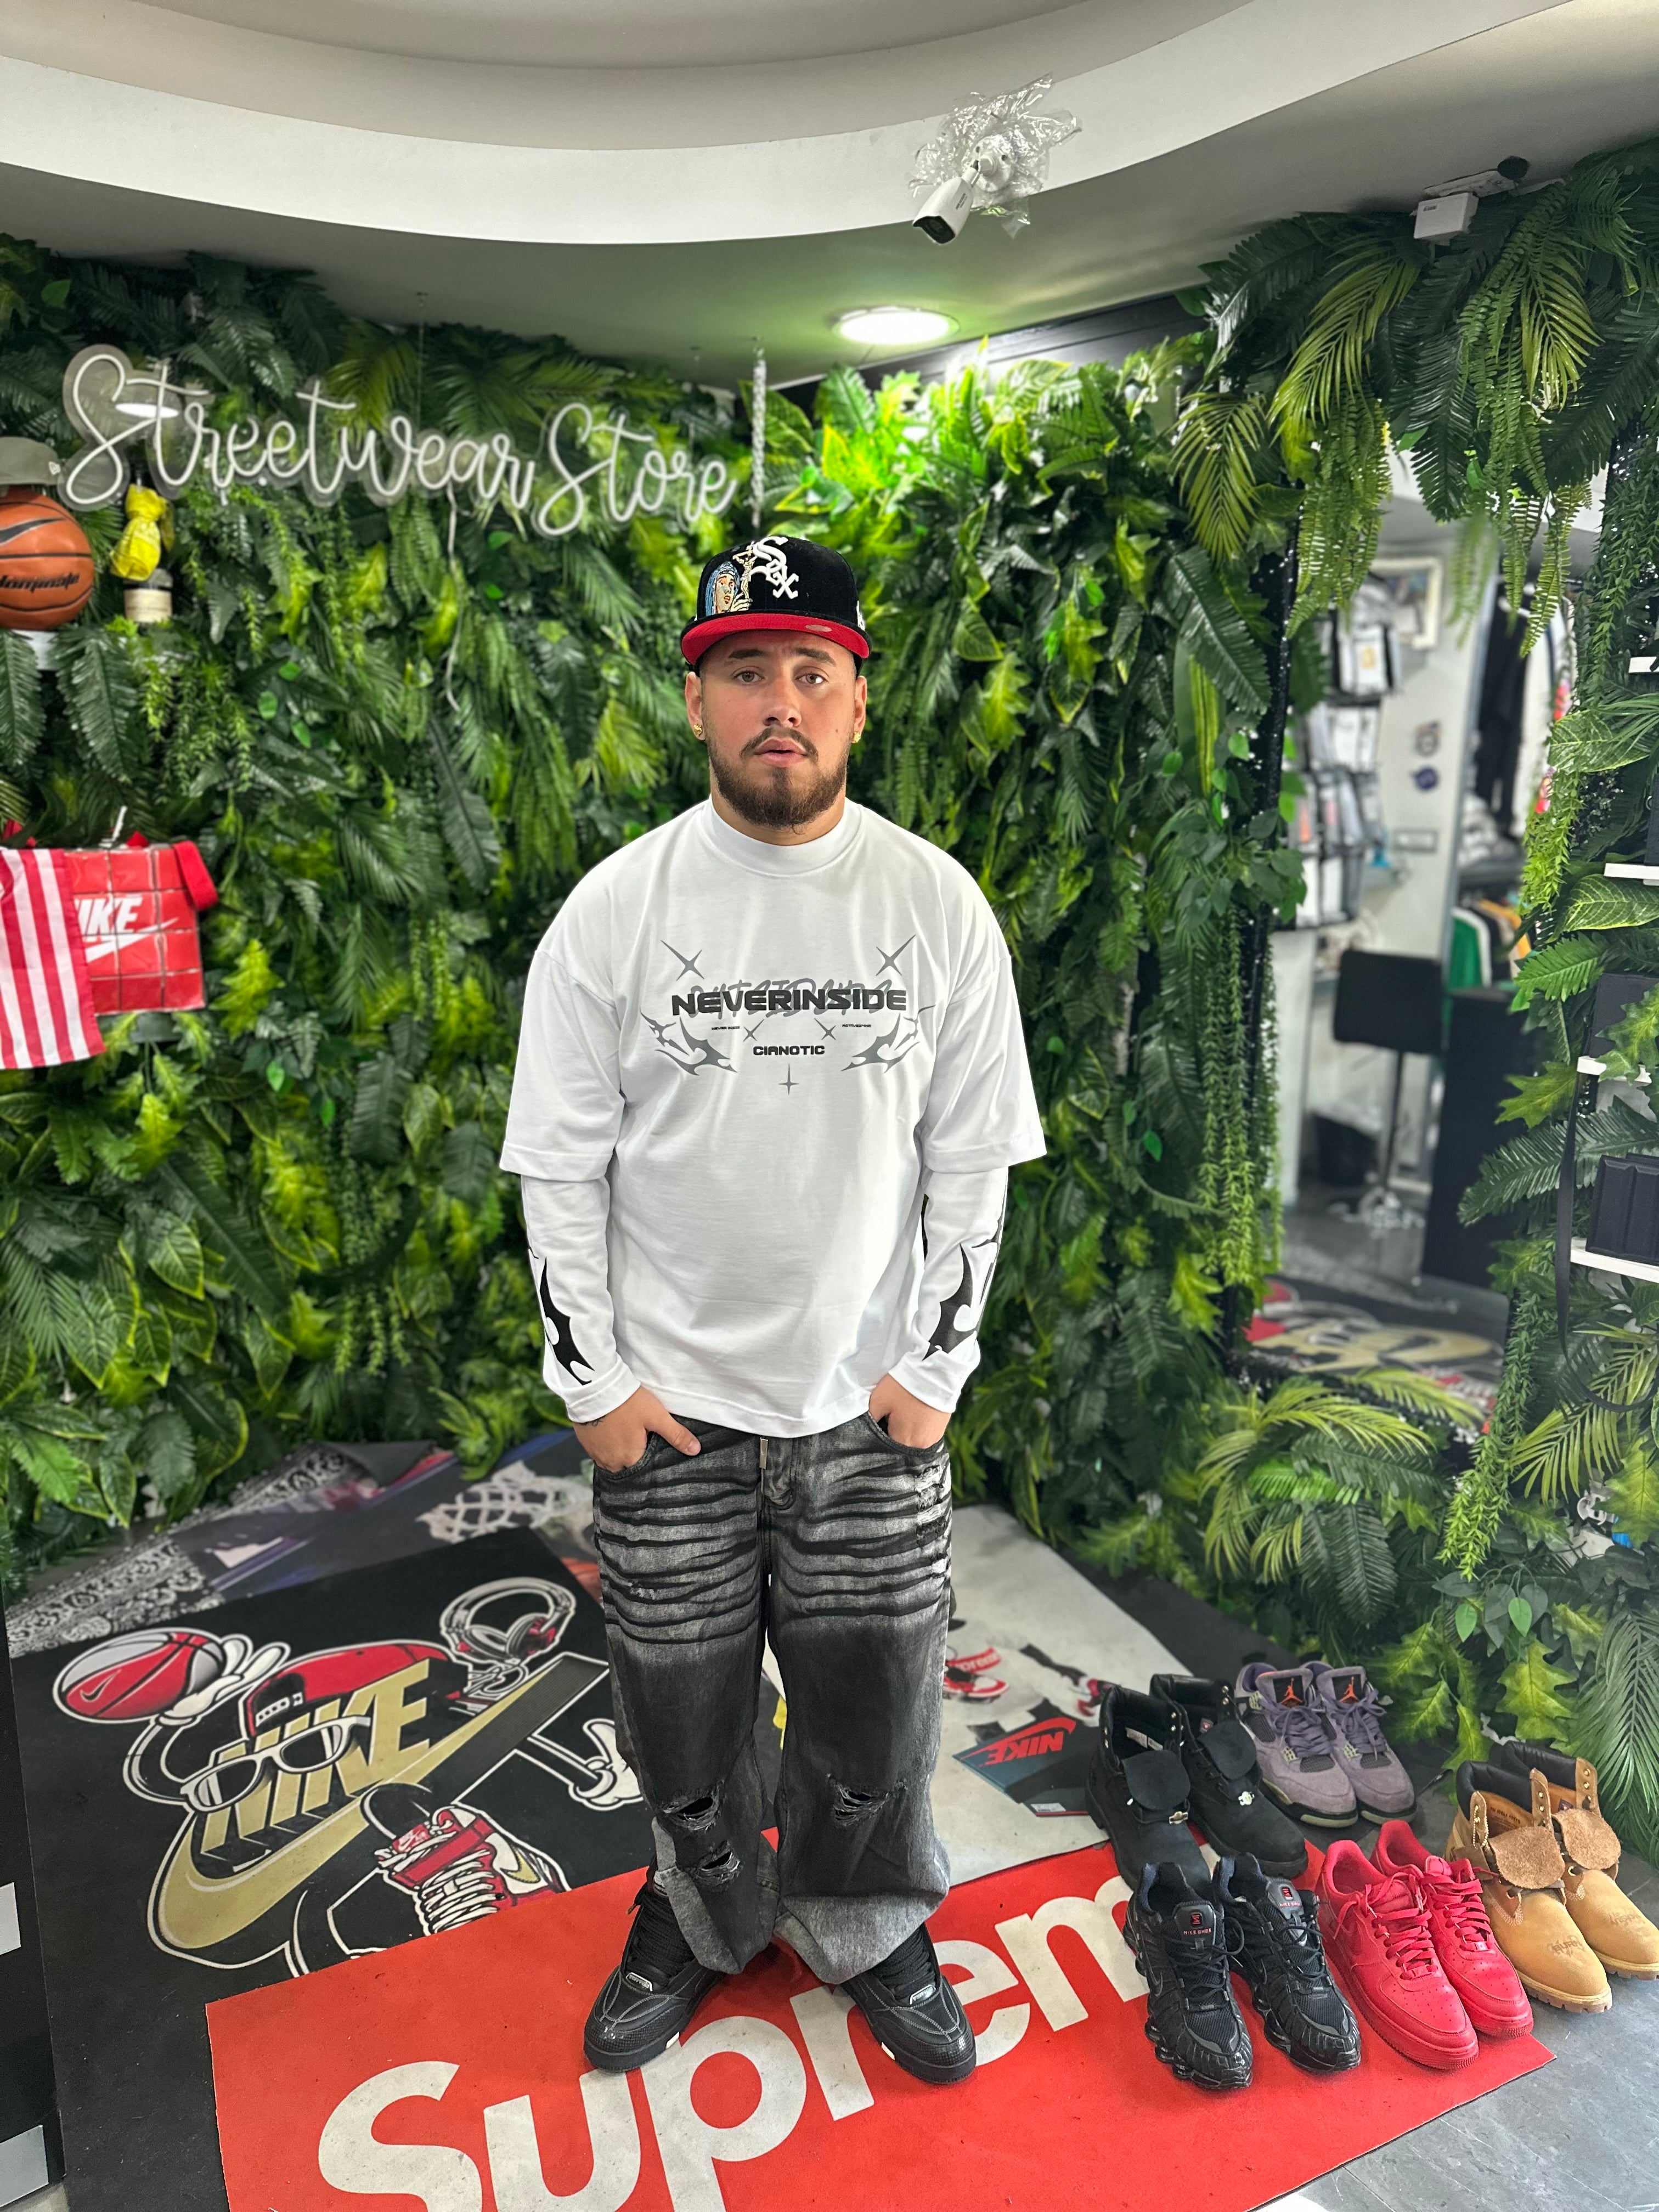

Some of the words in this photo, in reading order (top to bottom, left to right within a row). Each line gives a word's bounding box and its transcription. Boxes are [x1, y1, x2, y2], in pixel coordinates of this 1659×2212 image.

[65, 353, 536, 510] Streetwear
[537, 402, 738, 536] Store
[74, 895, 143, 943] IKE
[672, 989, 907, 1016] NEVERINSIDE
[753, 1045, 826, 1056] CIANOTIC
[984, 1731, 1064, 1765] NIKE
[318, 1843, 1221, 2212] Suprem
